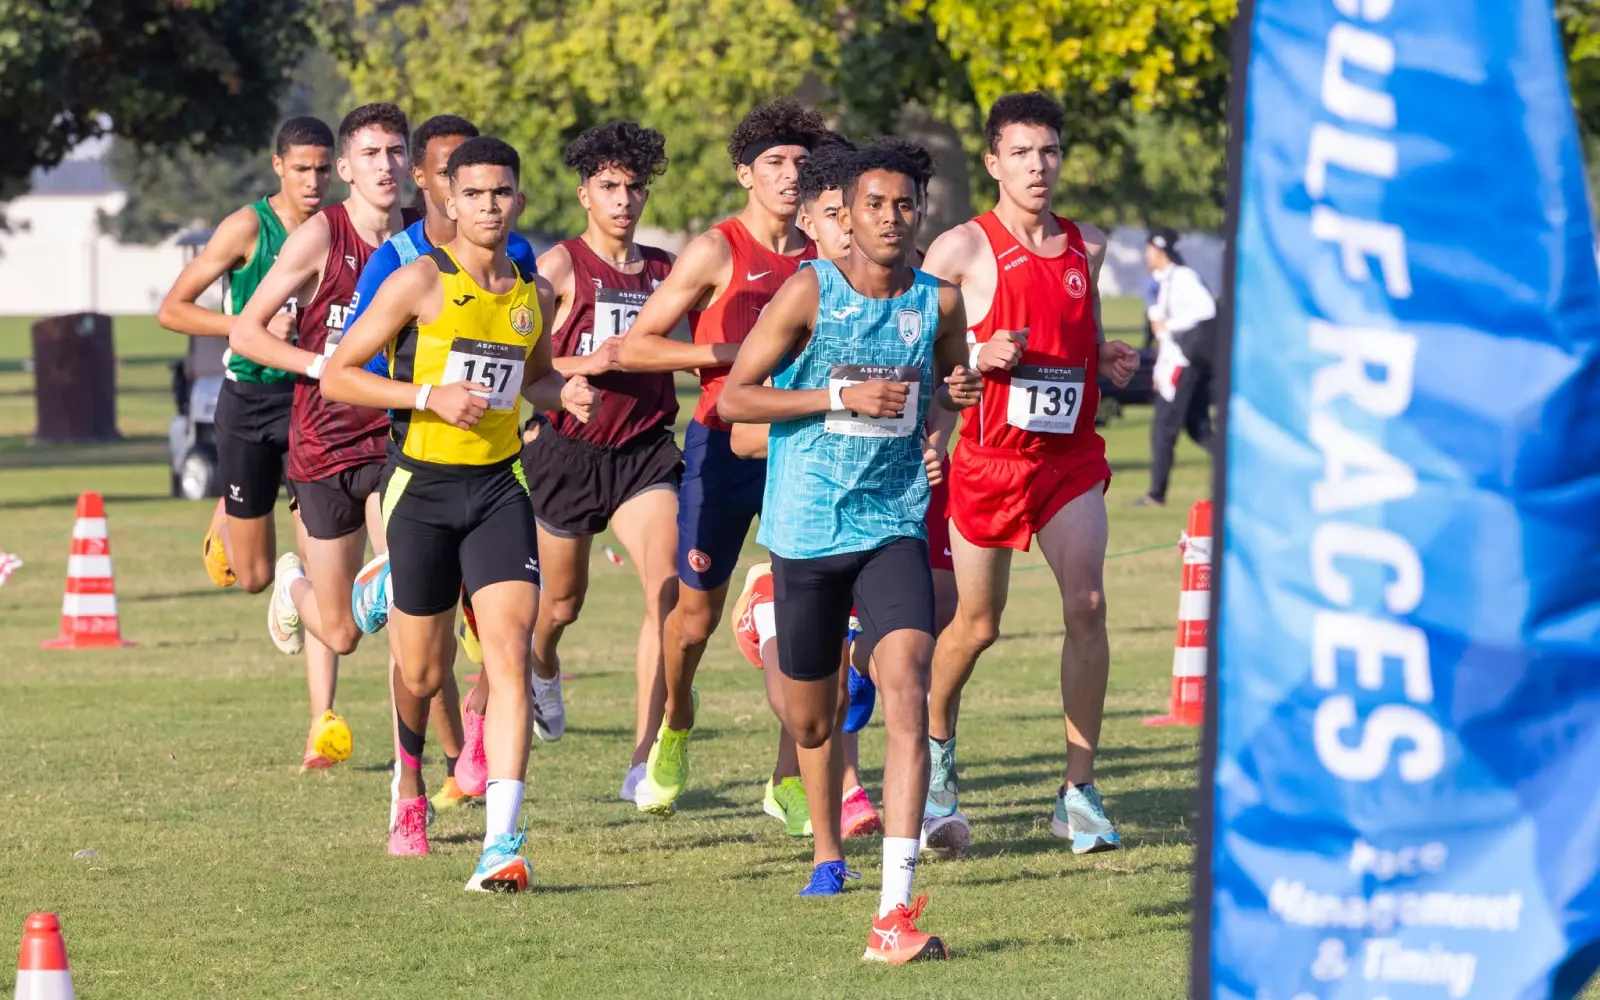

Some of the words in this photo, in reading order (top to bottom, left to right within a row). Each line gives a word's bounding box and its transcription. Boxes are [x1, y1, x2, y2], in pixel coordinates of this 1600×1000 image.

[1304, 0, 1413, 299] ULF
[476, 342, 509, 352] ASPETAR
[463, 359, 513, 393] 157
[859, 366, 900, 376] ASPETAR
[1037, 367, 1072, 375] ASPETAR
[1026, 385, 1078, 417] 139
[1305, 317, 1446, 784] RACES
[1267, 877, 1524, 933] Management
[1309, 938, 1349, 983] &
[1361, 937, 1479, 999] Timing
